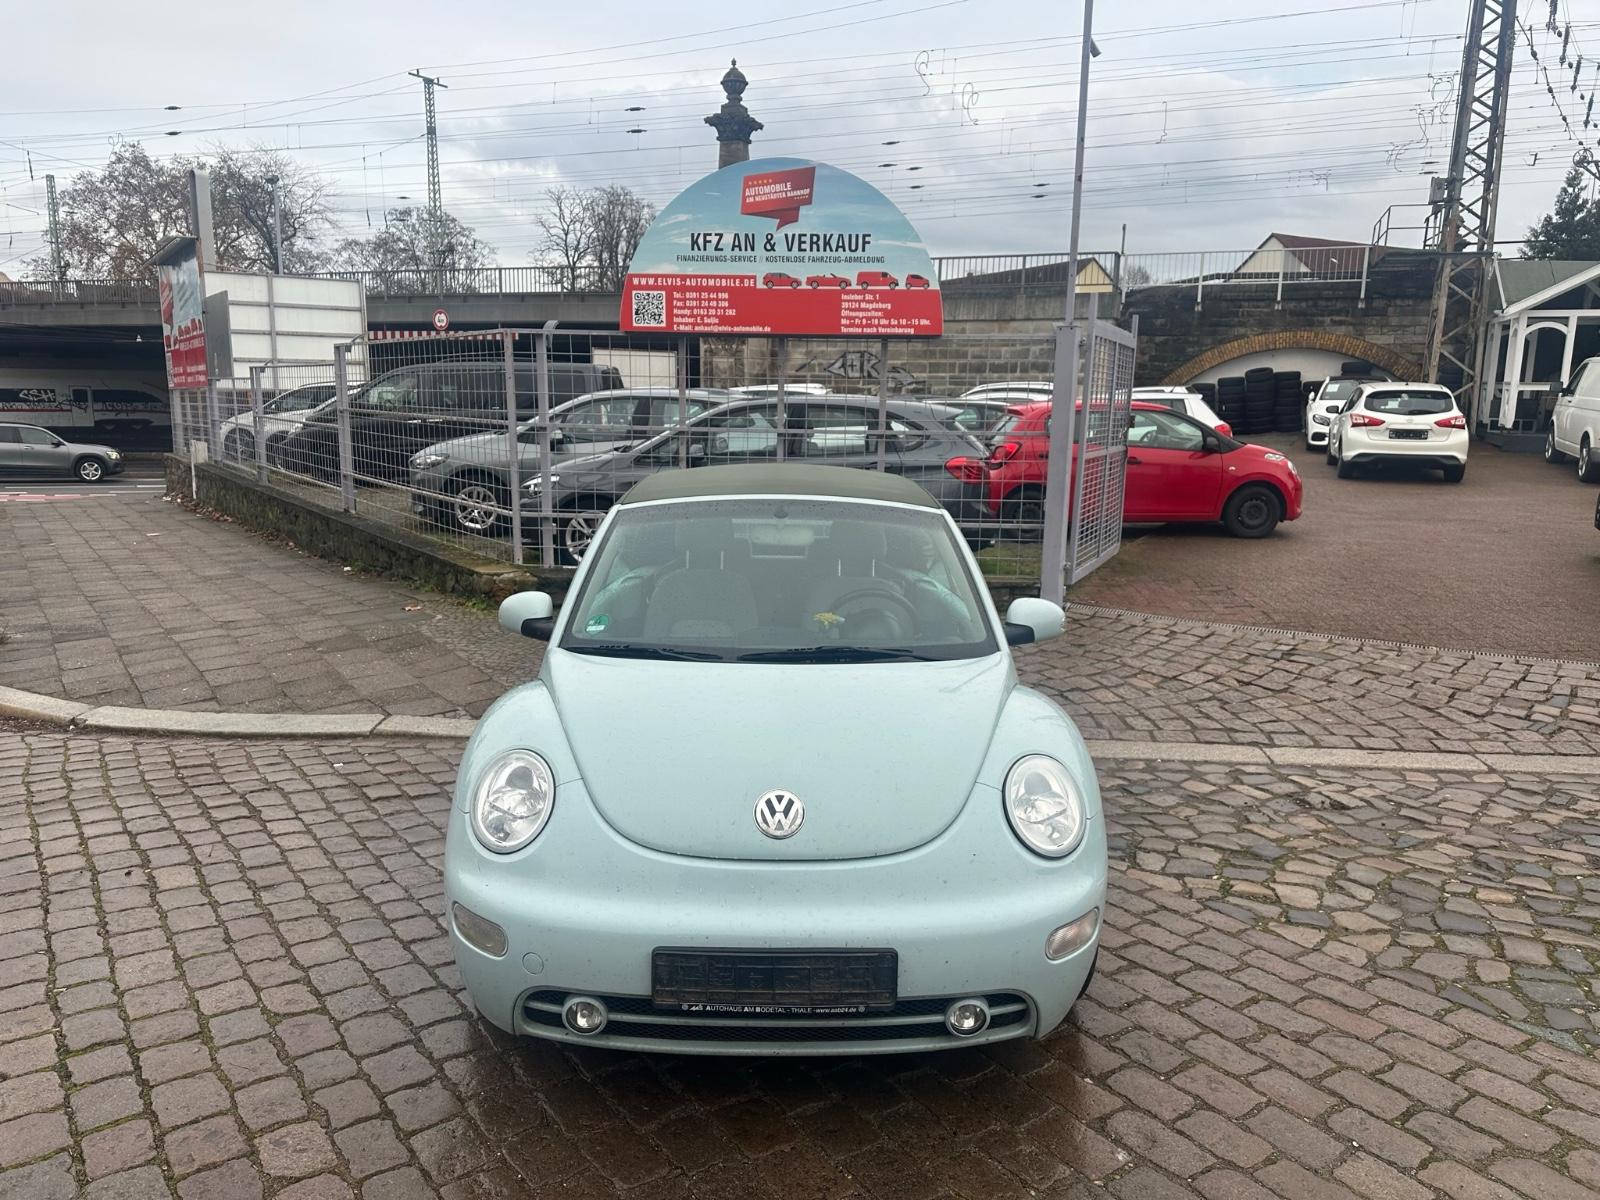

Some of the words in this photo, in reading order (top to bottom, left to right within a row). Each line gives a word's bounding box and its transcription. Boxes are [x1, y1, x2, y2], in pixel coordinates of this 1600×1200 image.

[745, 182, 792, 197] AUTOMOBILE
[755, 192, 786, 202] NEUSTÄDTER
[787, 188, 811, 197] BAHNHOF
[690, 232, 724, 252] KFZ
[731, 232, 756, 252] AN
[763, 232, 776, 252] &
[784, 233, 872, 253] VERKAUF
[676, 254, 757, 263] FINANZIERUNGS-SERVICE
[765, 255, 805, 263] KOSTENLOSE
[808, 255, 885, 264] FAHRZEUG-ABMELDUNG
[632, 277, 755, 287] WWW.ELVIS-AUTOMOBILE.DE
[860, 302, 891, 310] Magdeburg
[673, 308, 691, 316] Handy:
[841, 309, 884, 318] Öffnungszeiten:
[878, 327, 914, 335] Vereinbarung
[756, 790, 804, 837] VW
